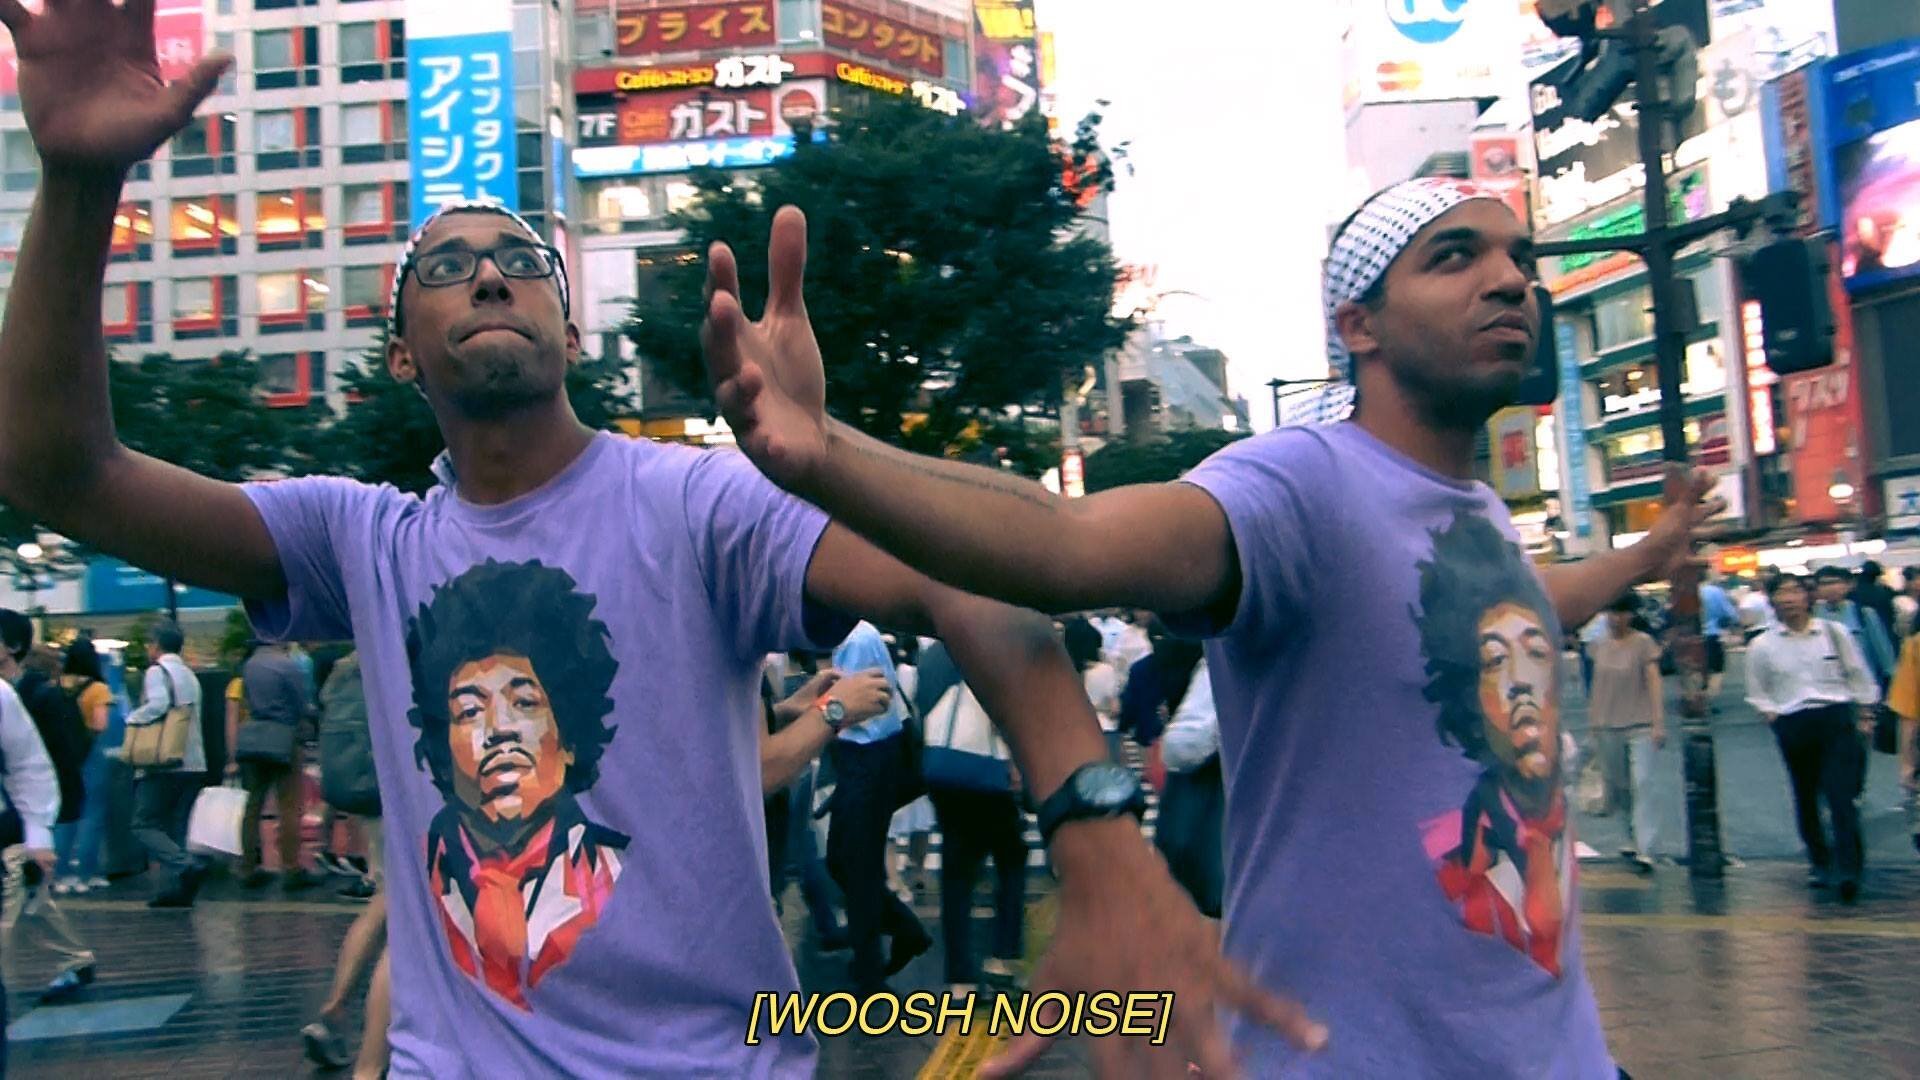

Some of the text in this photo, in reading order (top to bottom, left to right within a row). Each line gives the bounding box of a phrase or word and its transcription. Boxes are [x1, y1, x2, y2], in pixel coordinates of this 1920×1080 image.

[822, 5, 939, 62] コンタクト
[714, 54, 795, 87] ガスト
[470, 53, 505, 204] コンタクト
[670, 99, 768, 139] ガスト
